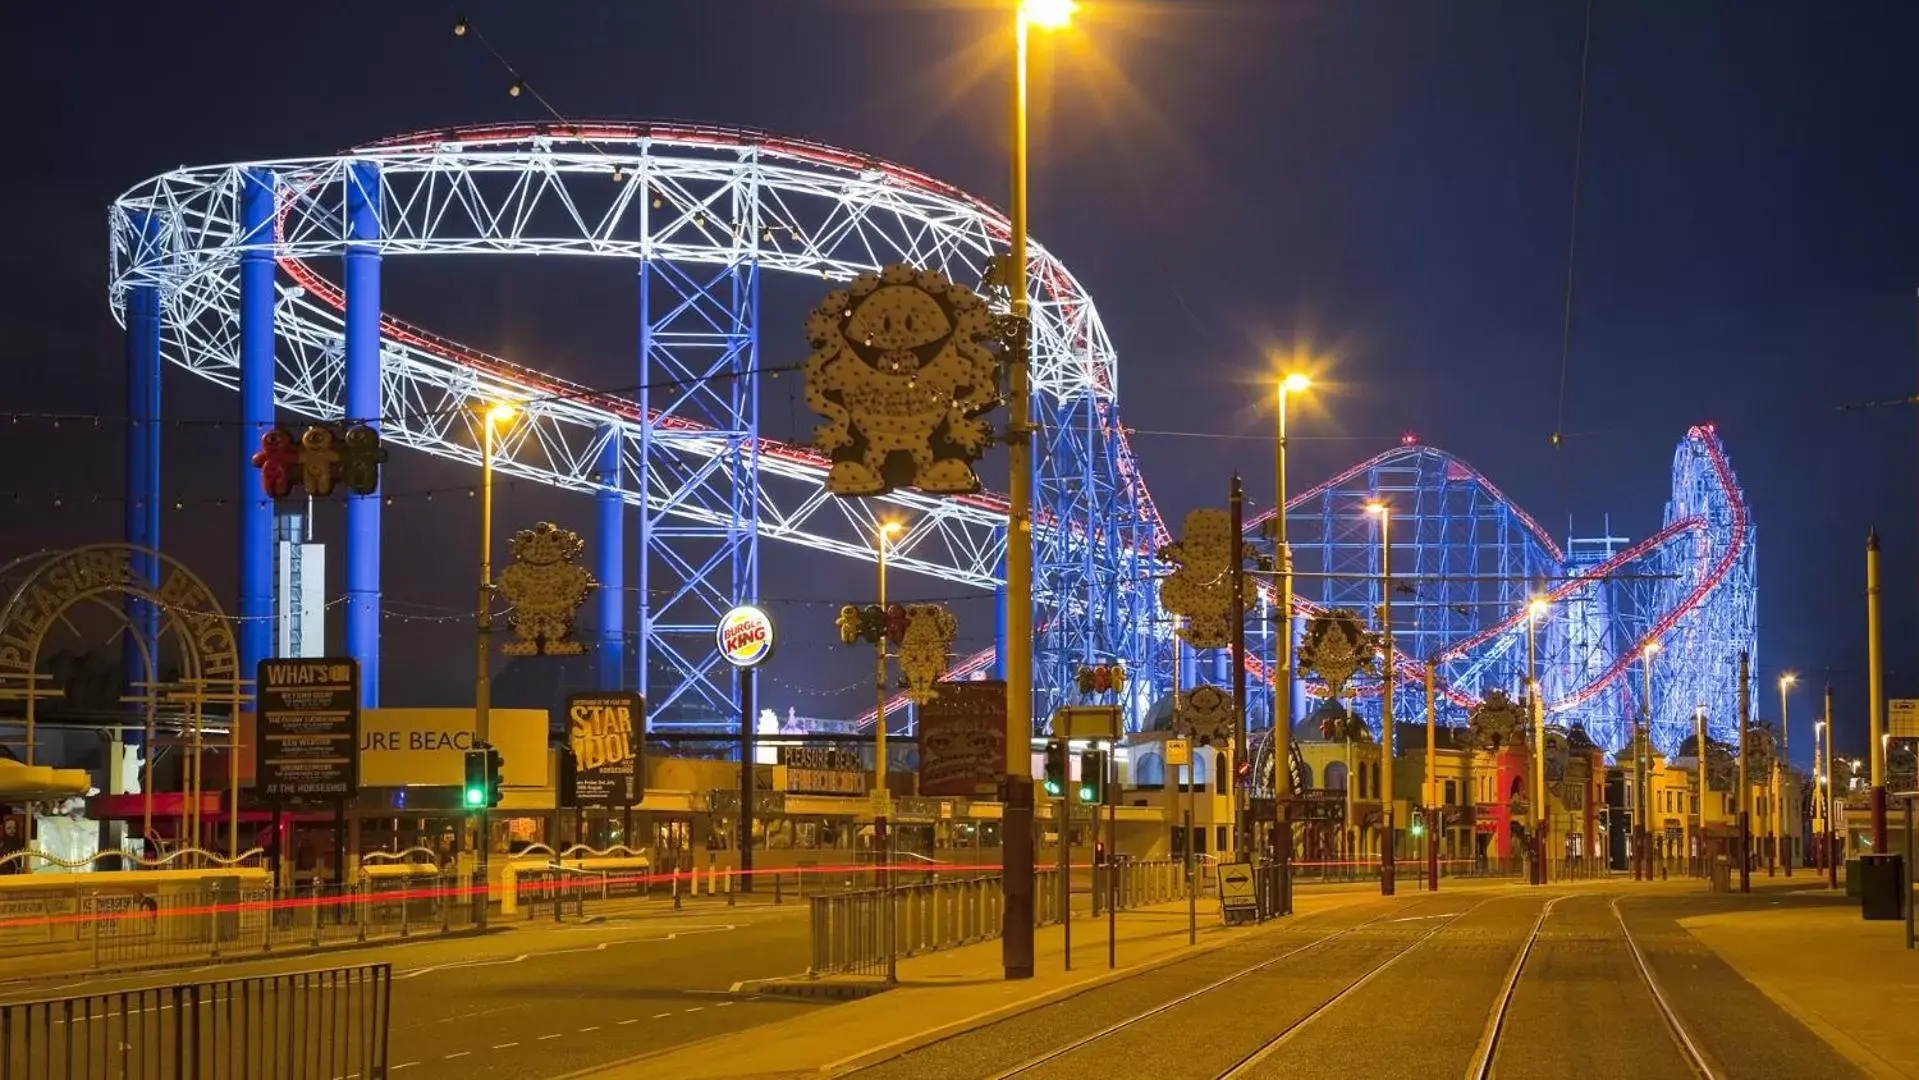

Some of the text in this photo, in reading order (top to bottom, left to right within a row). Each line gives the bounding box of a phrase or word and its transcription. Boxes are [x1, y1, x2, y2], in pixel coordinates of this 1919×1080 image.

[0, 550, 235, 675] PLEASURE BEACH
[727, 626, 766, 654] KING
[267, 665, 328, 685] WHAT'S
[571, 705, 632, 737] STAR
[573, 733, 637, 772] IDOL
[785, 746, 862, 770] PLEASURE BEACH
[266, 784, 277, 793] AT
[279, 783, 296, 793] THE
